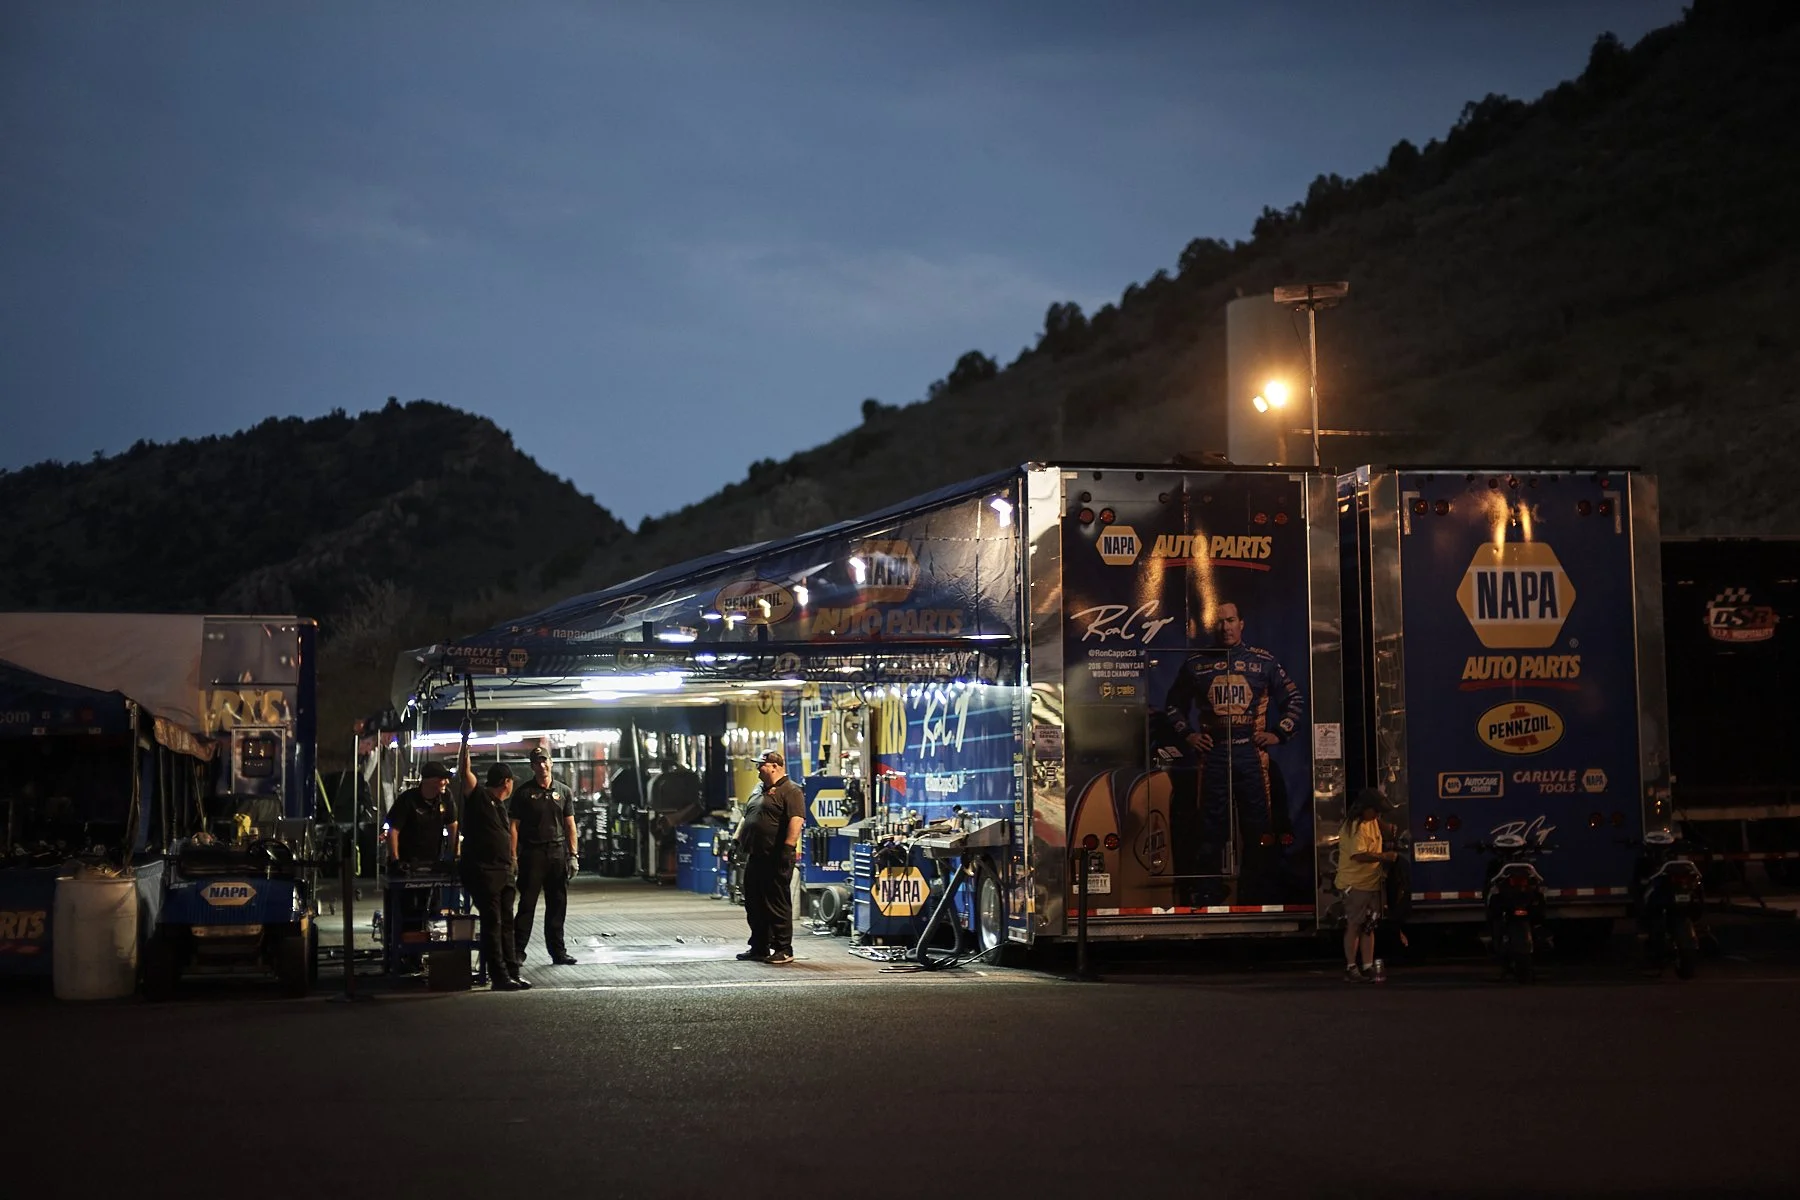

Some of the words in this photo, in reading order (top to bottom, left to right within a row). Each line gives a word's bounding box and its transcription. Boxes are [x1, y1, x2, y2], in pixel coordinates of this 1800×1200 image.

[1104, 536, 1135, 554] NAPA
[1151, 535, 1209, 558] AUTO
[1210, 536, 1273, 559] PARTS
[1477, 571, 1559, 619] NAPA
[812, 607, 882, 634] AUTO
[887, 608, 964, 635] PARTS
[447, 646, 503, 658] CARLYLE
[1088, 649, 1137, 658] @RonCapps28
[1462, 656, 1517, 680] AUTO
[1520, 655, 1581, 679] PARTS
[1214, 685, 1246, 705] NAPA
[1489, 715, 1551, 740] PENNZOIL
[1512, 769, 1577, 783] CARLYLE
[1539, 783, 1577, 794] TOOLS
[818, 800, 848, 817] NAP
[209, 886, 248, 898] NAPA
[881, 880, 921, 903] NAPA
